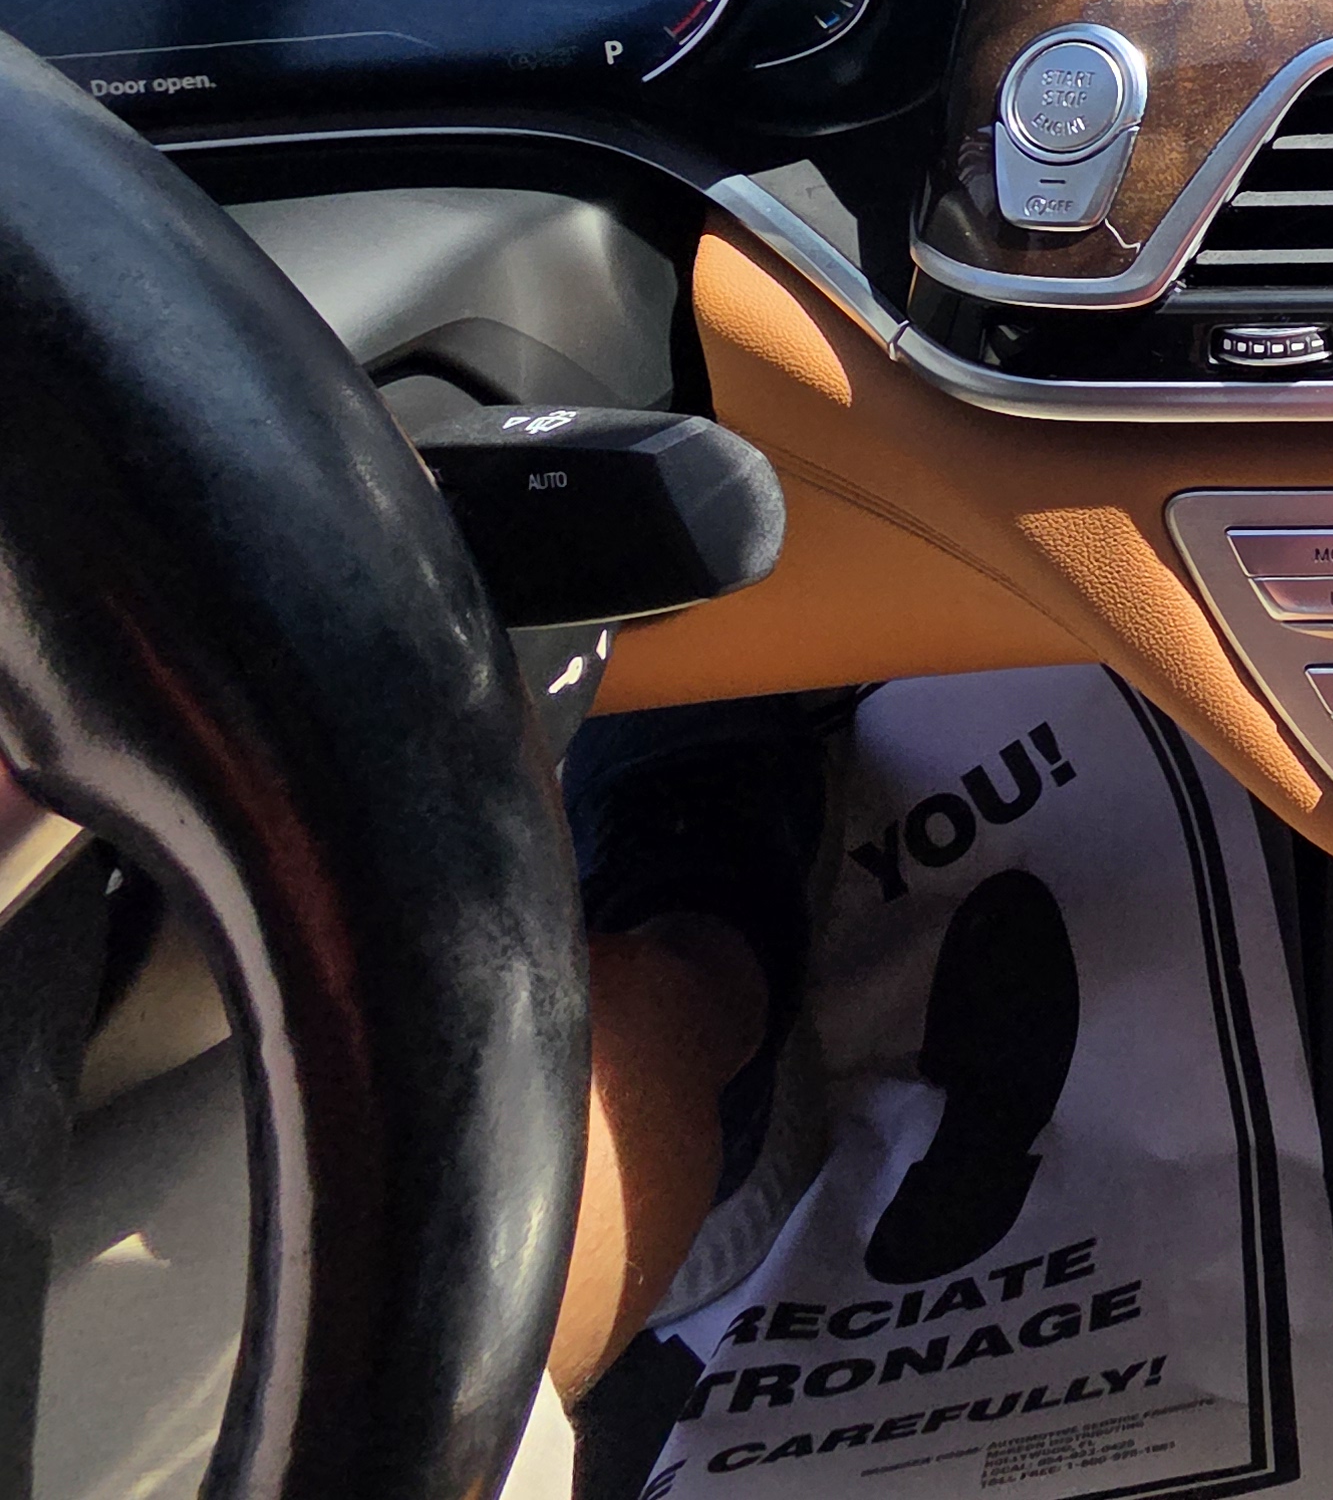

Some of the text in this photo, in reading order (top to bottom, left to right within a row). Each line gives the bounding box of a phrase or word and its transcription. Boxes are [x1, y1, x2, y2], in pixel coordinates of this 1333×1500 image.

[603, 40, 624, 66] P
[90, 74, 217, 97] Door open.
[1040, 68, 1096, 88] START
[1041, 89, 1088, 108] STOP
[1031, 112, 1086, 137] ENGINE
[528, 471, 568, 490] AUTO
[848, 720, 1078, 903] YOU!
[706, 1355, 1168, 1475] CAREFULLY!
